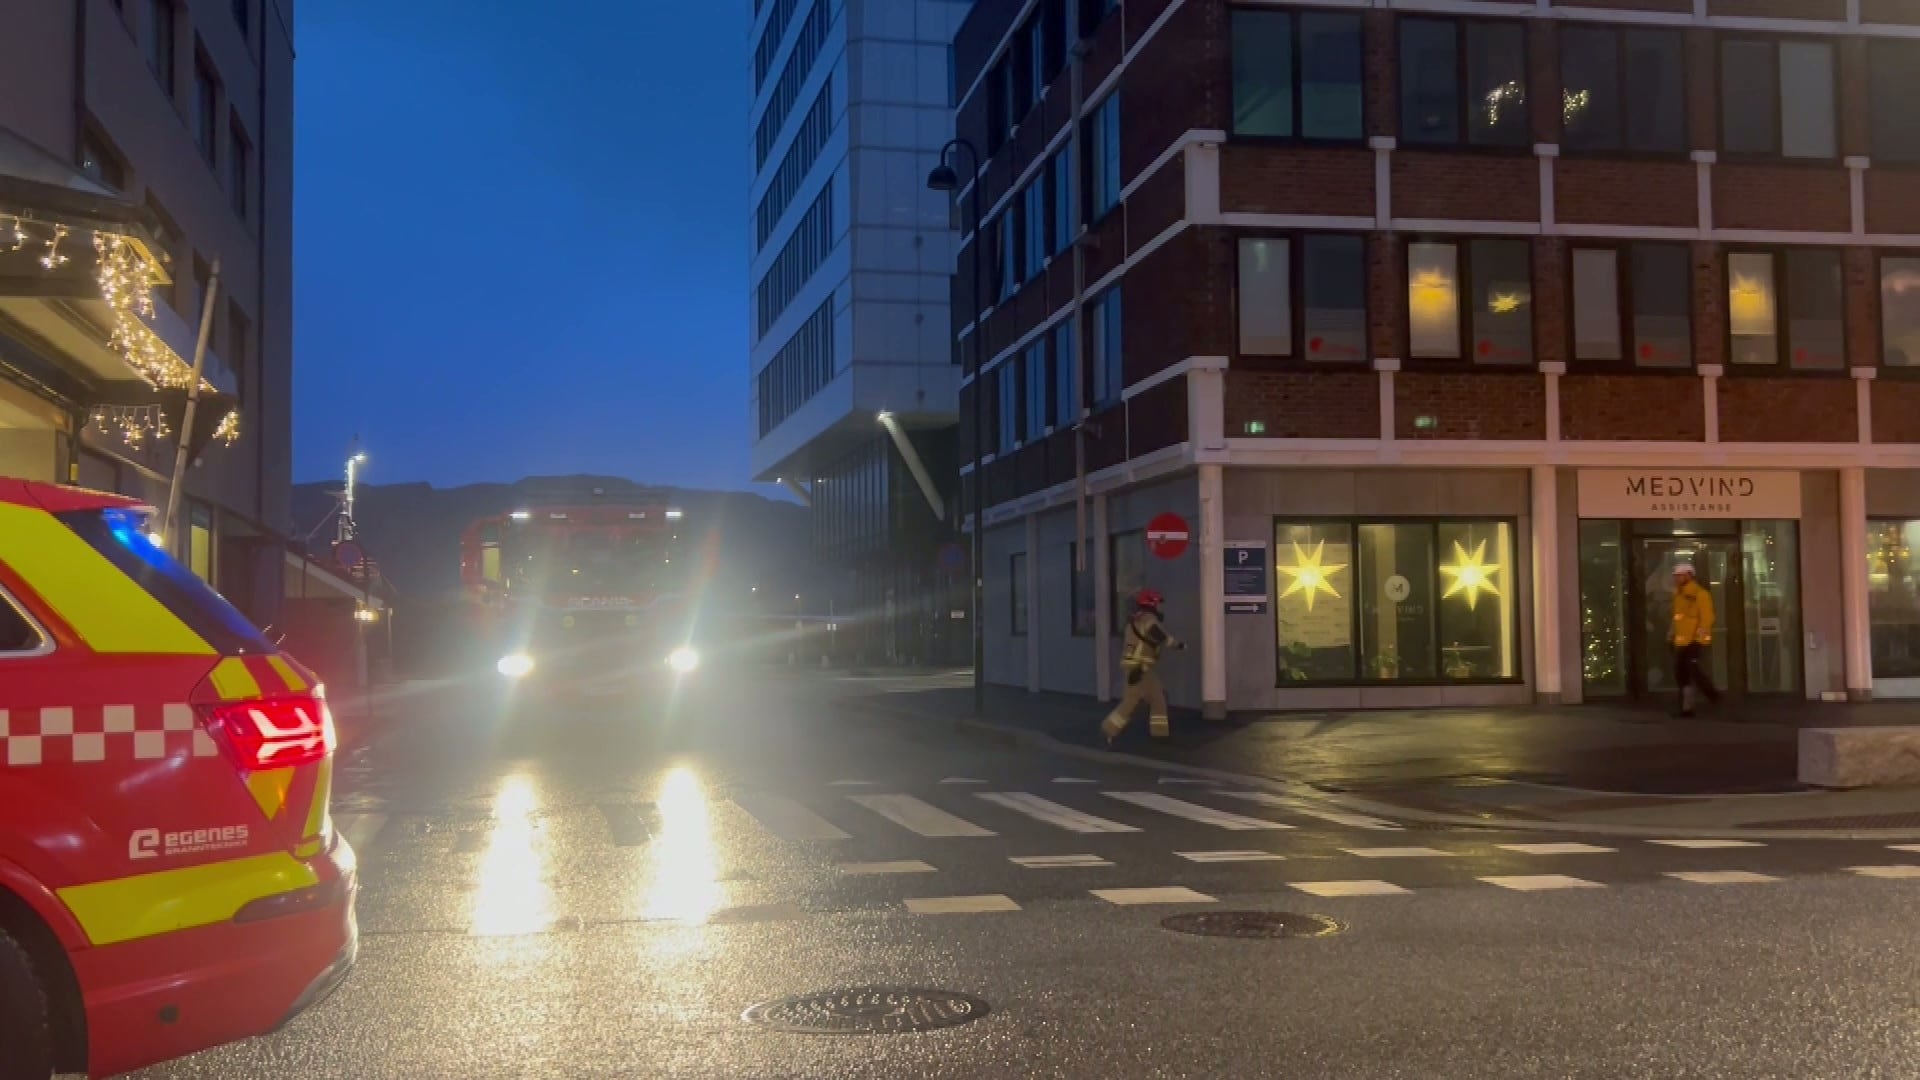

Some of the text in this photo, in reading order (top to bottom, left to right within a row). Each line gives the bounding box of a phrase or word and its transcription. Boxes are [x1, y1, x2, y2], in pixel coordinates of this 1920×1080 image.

[1626, 477, 1754, 497] MEDVIND
[1651, 503, 1732, 513] ASSISTANSE
[1238, 551, 1249, 565] P
